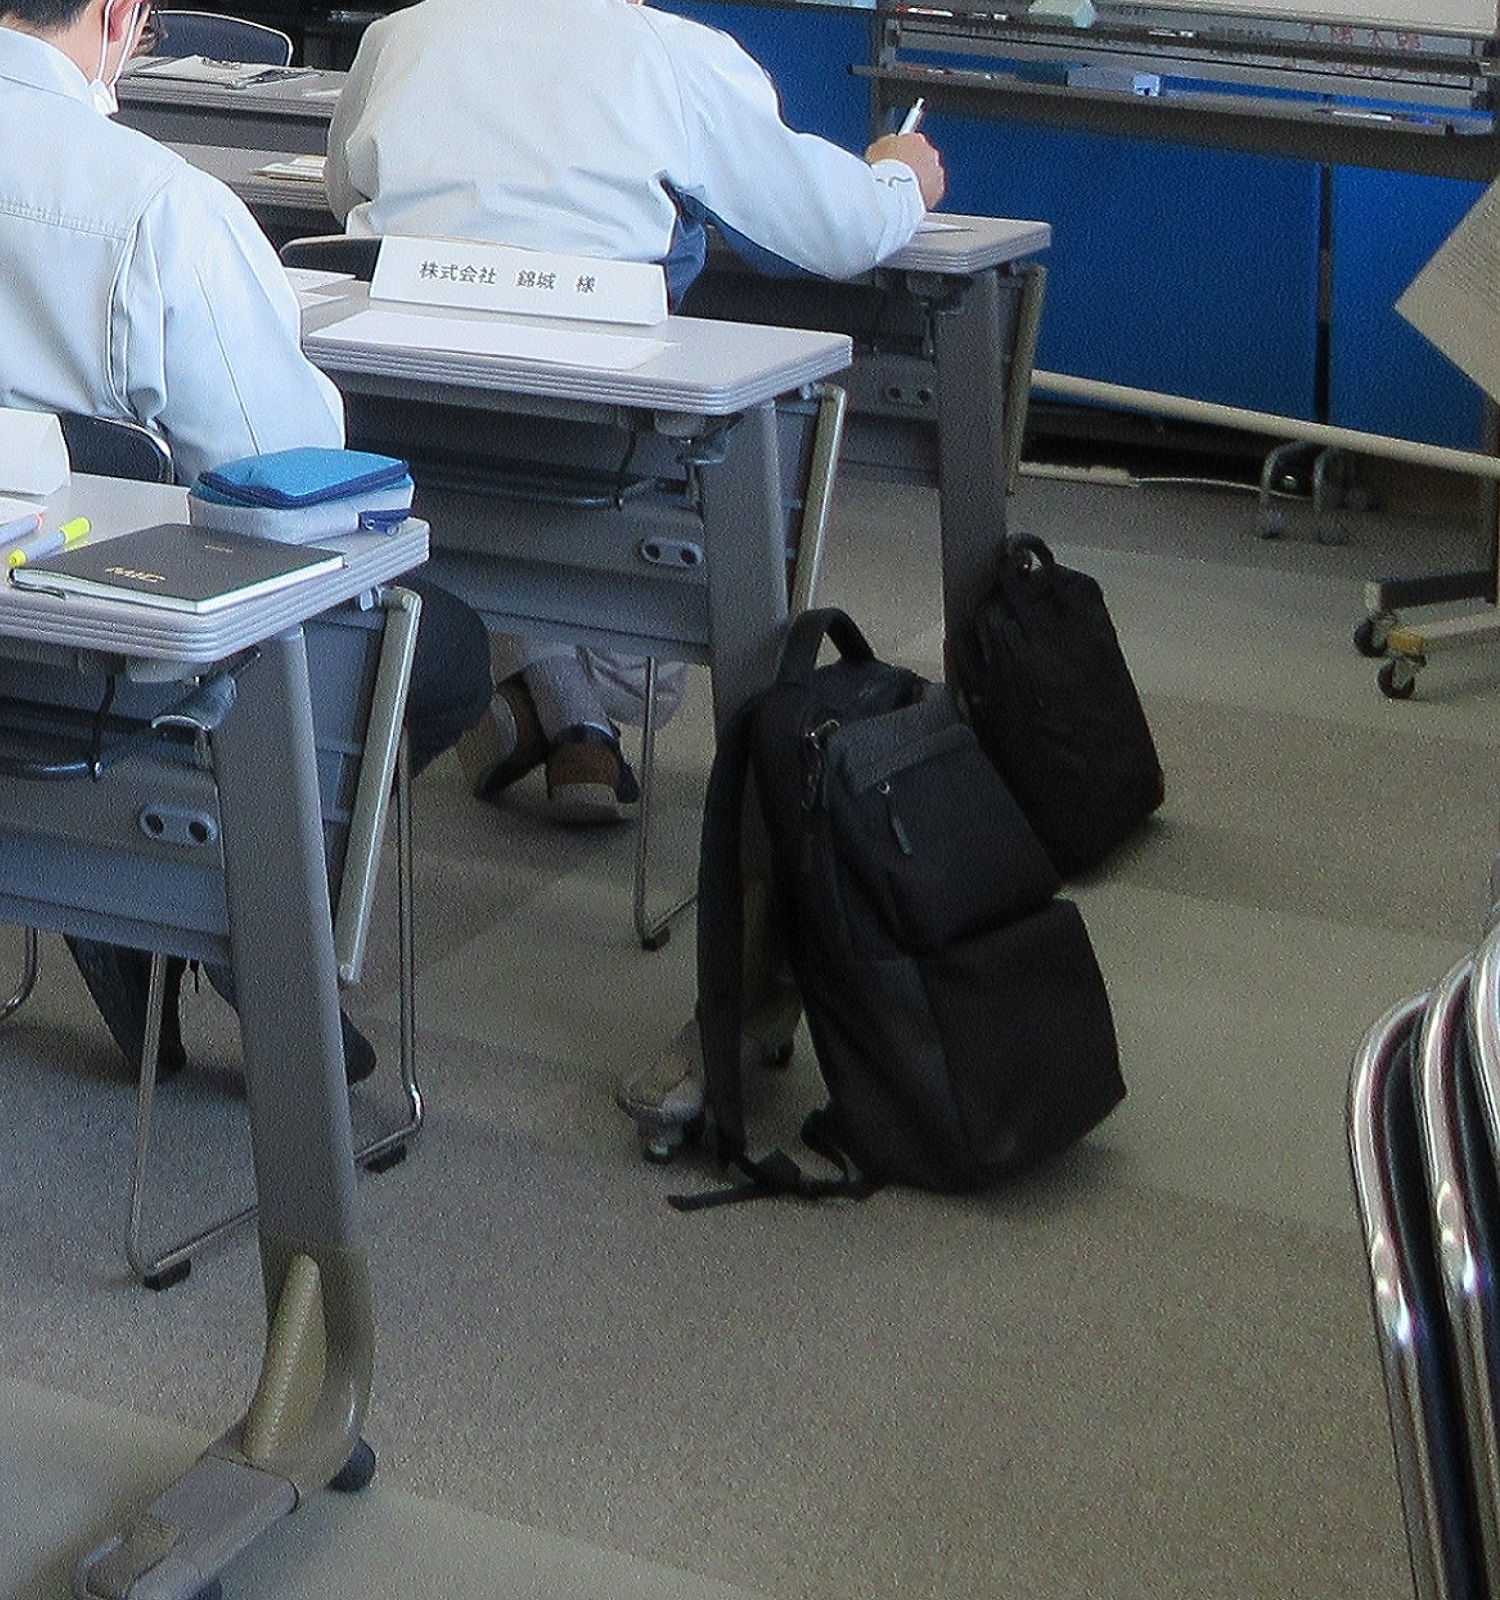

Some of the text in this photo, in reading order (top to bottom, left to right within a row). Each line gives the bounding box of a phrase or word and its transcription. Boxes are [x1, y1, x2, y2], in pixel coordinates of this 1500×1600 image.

[419, 260, 498, 286] 株式会社
[575, 274, 597, 294] 様
